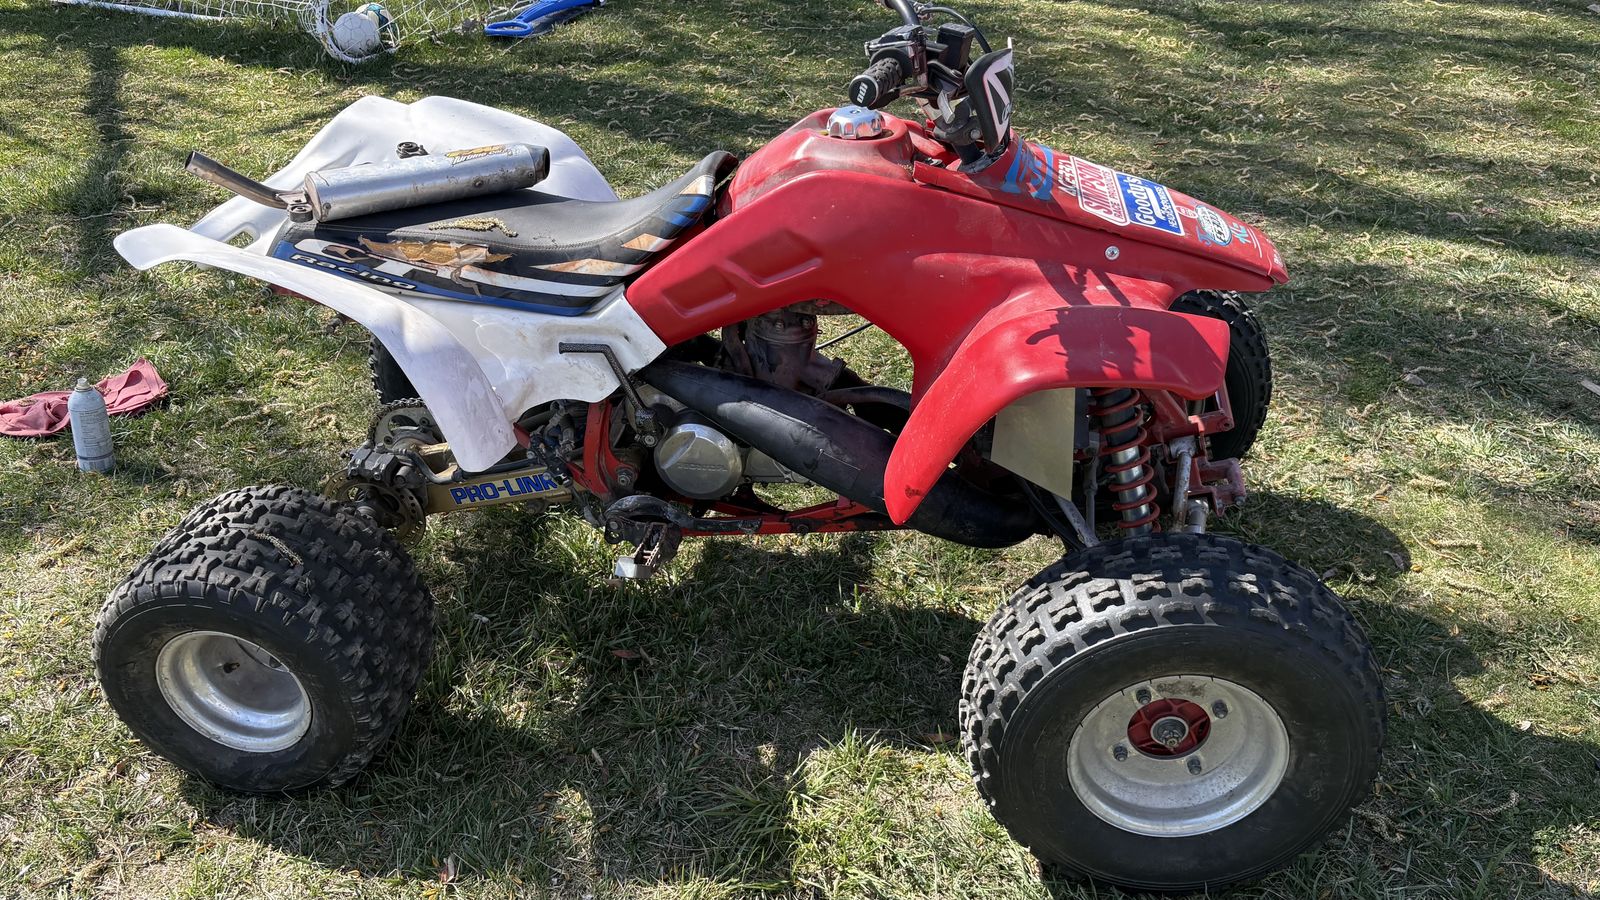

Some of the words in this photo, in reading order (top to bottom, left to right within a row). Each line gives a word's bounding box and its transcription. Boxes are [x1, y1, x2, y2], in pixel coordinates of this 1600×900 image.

[1075, 162, 1113, 215] SIMPSON
[1123, 177, 1158, 225] Goody's
[1110, 201, 1124, 219] RACE
[290, 254, 417, 290] Racing
[450, 473, 558, 504] PRO-LINK
